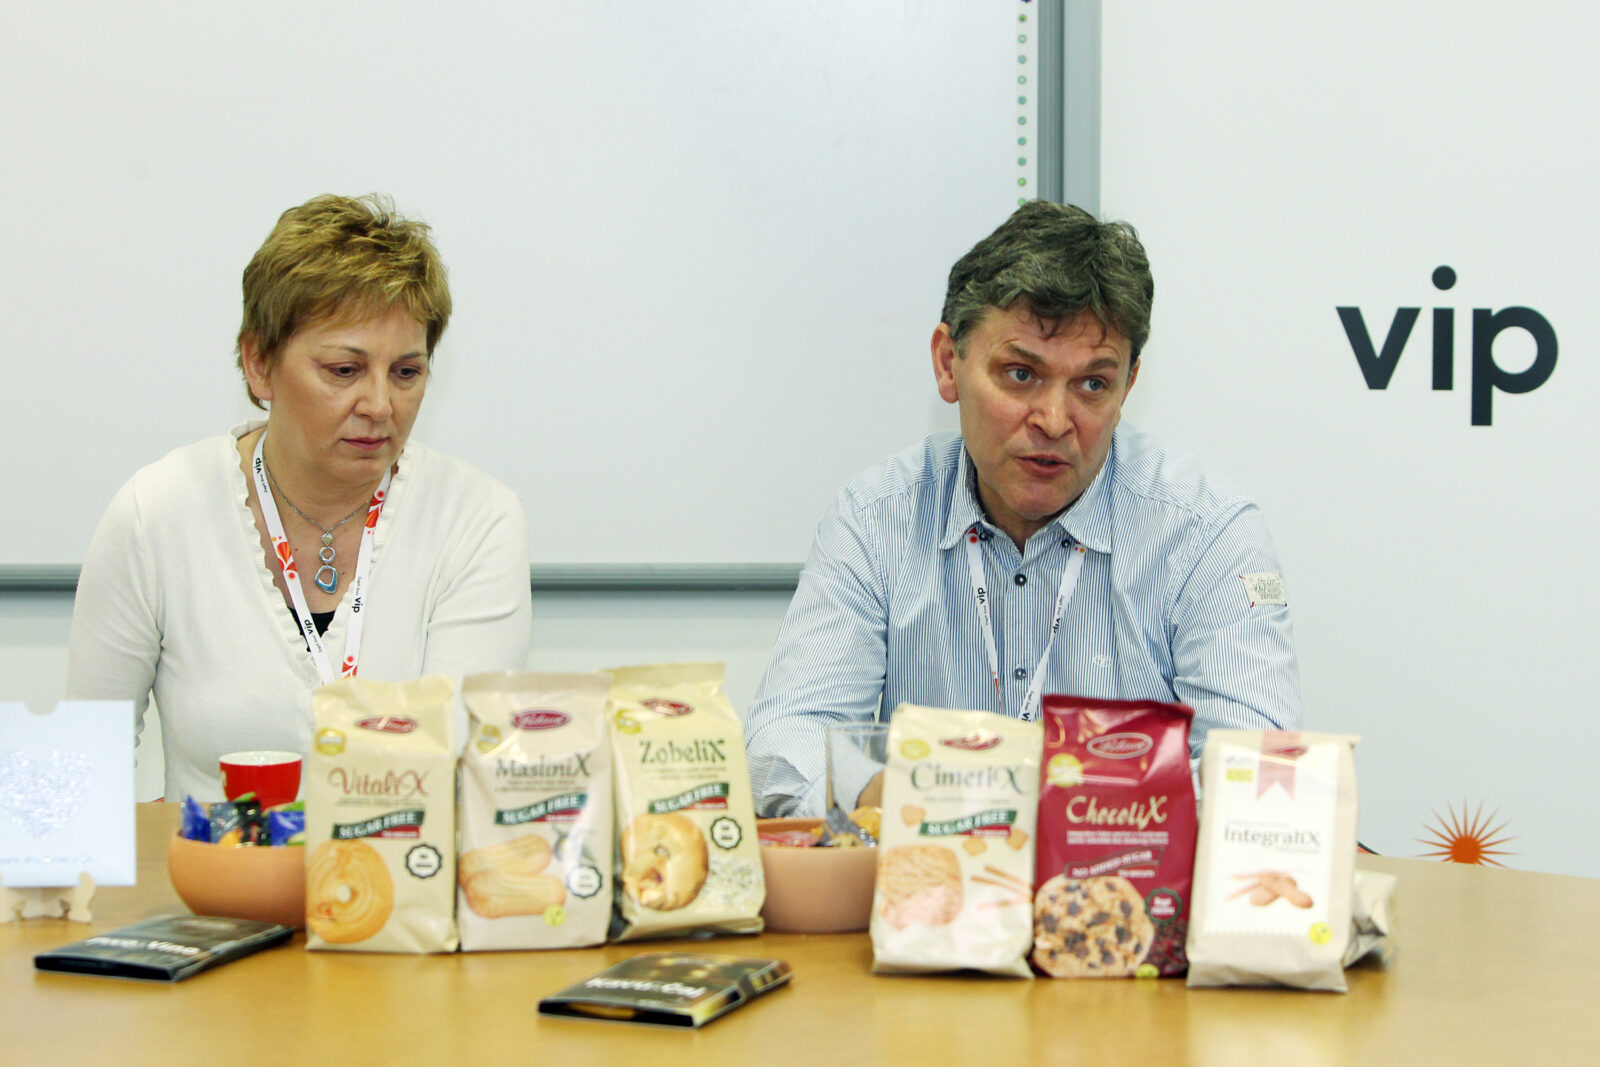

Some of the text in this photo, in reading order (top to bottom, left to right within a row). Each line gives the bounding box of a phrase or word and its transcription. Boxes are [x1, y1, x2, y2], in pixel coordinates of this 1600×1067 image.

[1335, 264, 1559, 426] vip
[254, 457, 262, 474] vip
[977, 587, 986, 604] vip
[352, 597, 363, 613] vip
[304, 619, 313, 635] vip
[639, 738, 726, 763] ZobeliX
[1066, 796, 1168, 830] ChocoliX
